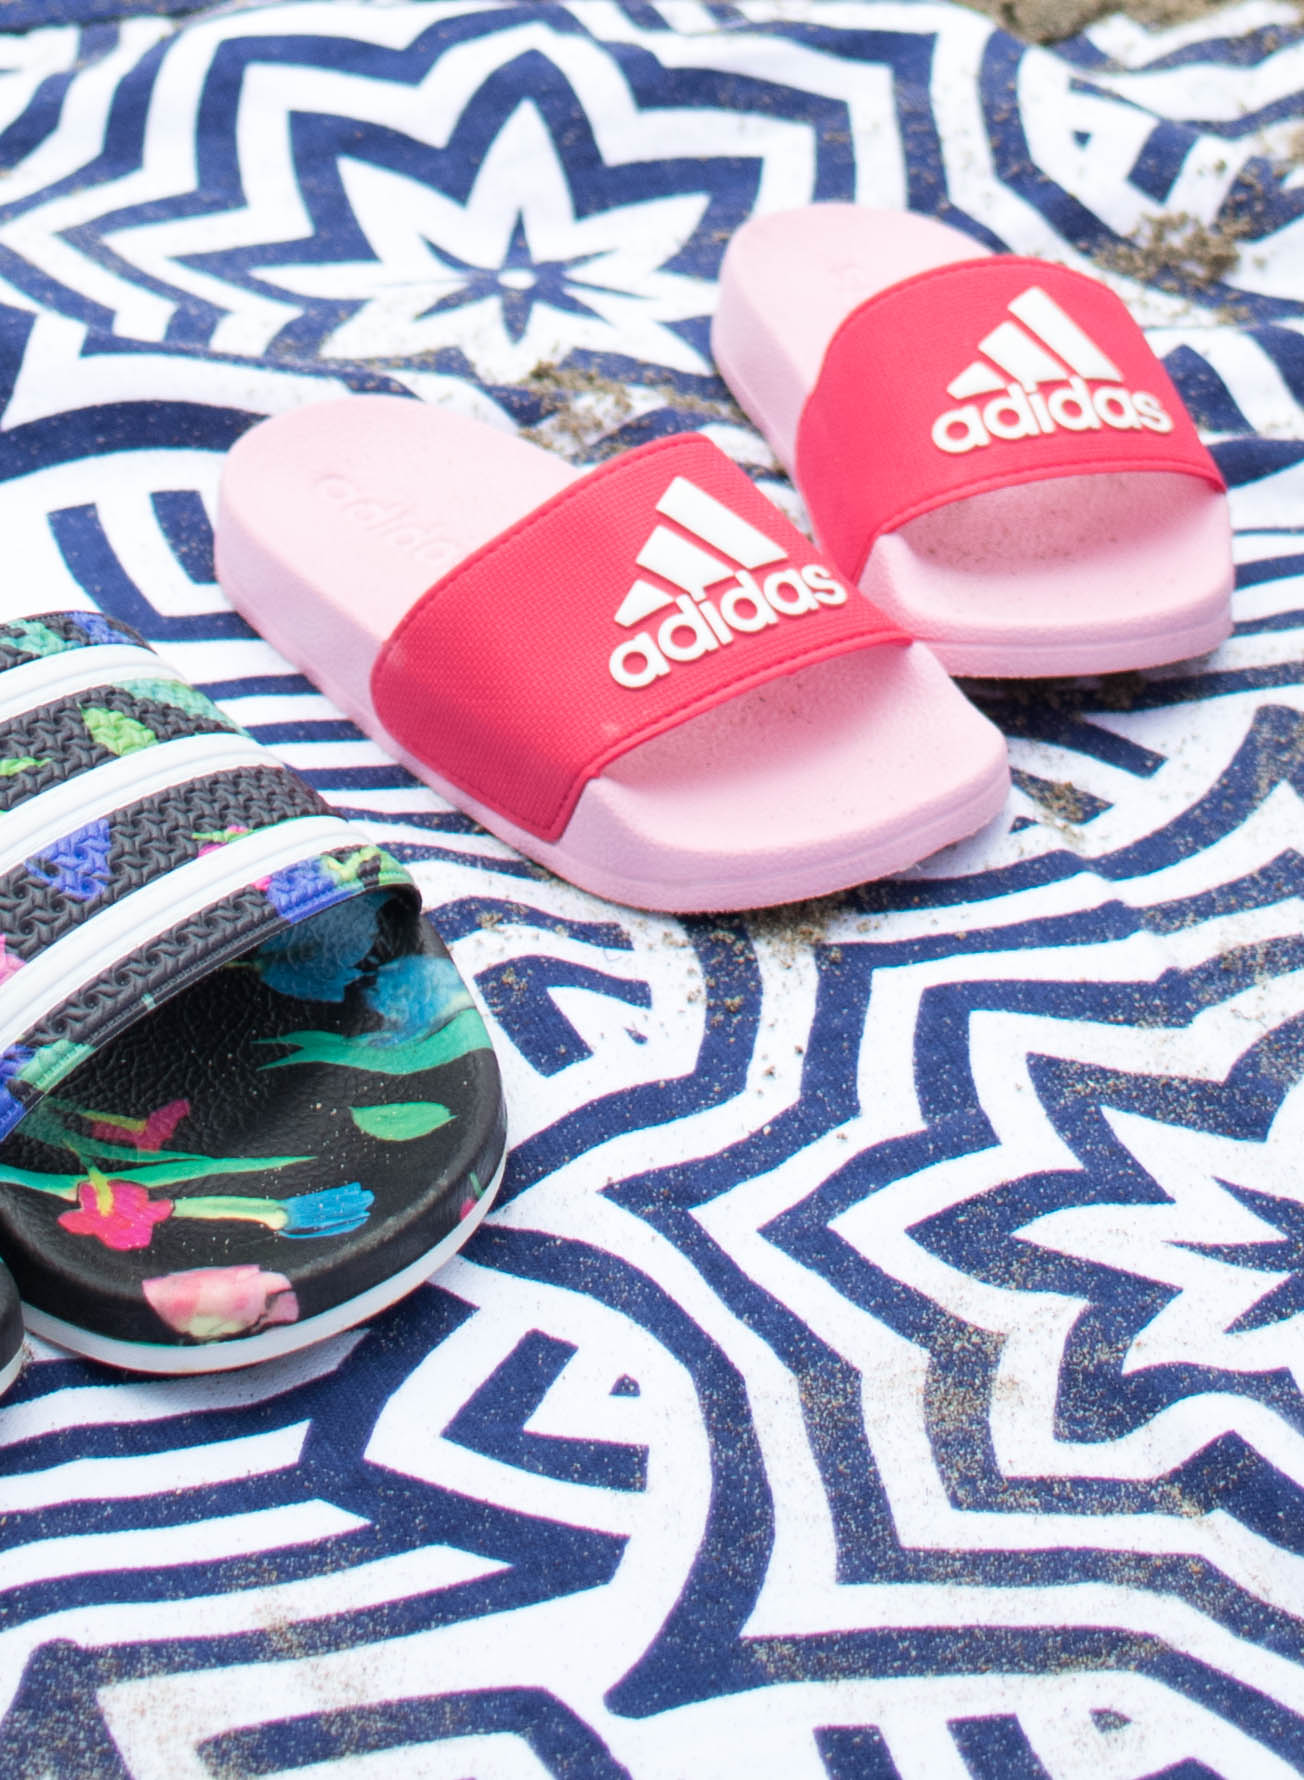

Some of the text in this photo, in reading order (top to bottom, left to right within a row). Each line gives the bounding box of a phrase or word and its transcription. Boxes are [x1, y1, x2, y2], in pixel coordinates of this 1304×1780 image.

[931, 375, 1174, 454] adidas
[310, 471, 465, 569] adida
[609, 565, 849, 688] adidas
